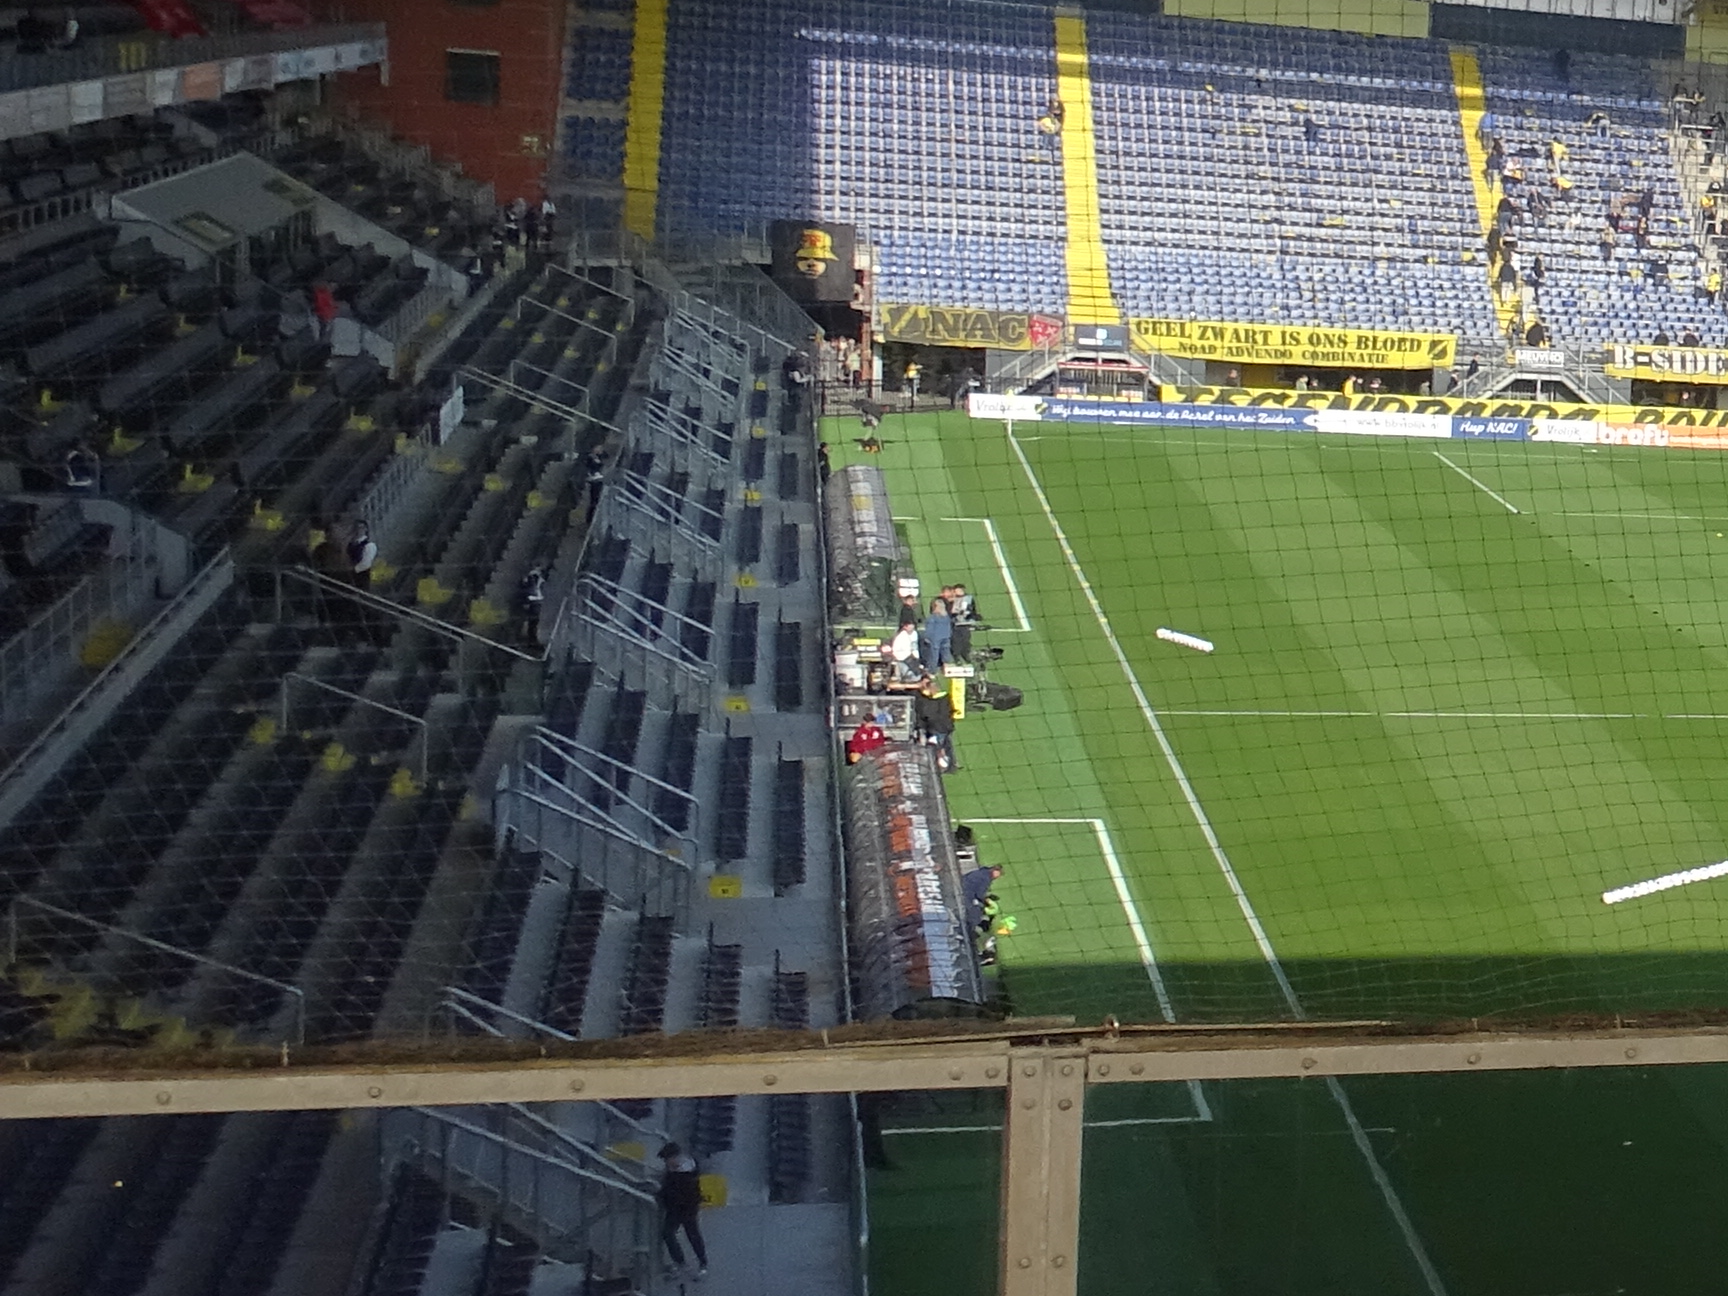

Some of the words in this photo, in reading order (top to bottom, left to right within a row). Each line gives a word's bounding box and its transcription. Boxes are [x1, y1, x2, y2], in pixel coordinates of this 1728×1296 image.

[926, 308, 1029, 345] NAC
[1136, 319, 1196, 340] GEEL
[1197, 324, 1273, 347] ZWART
[1281, 328, 1302, 347] IS
[1307, 330, 1348, 349] ONS
[1356, 334, 1422, 353] BLOED
[1178, 341, 1218, 356] NOAD
[1225, 345, 1294, 360] ADVENDO
[1301, 350, 1389, 365] COMBINATIE
[1613, 345, 1726, 377] B-SIDE
[1459, 420, 1485, 434] Hup
[1486, 422, 1518, 435] NAC!
